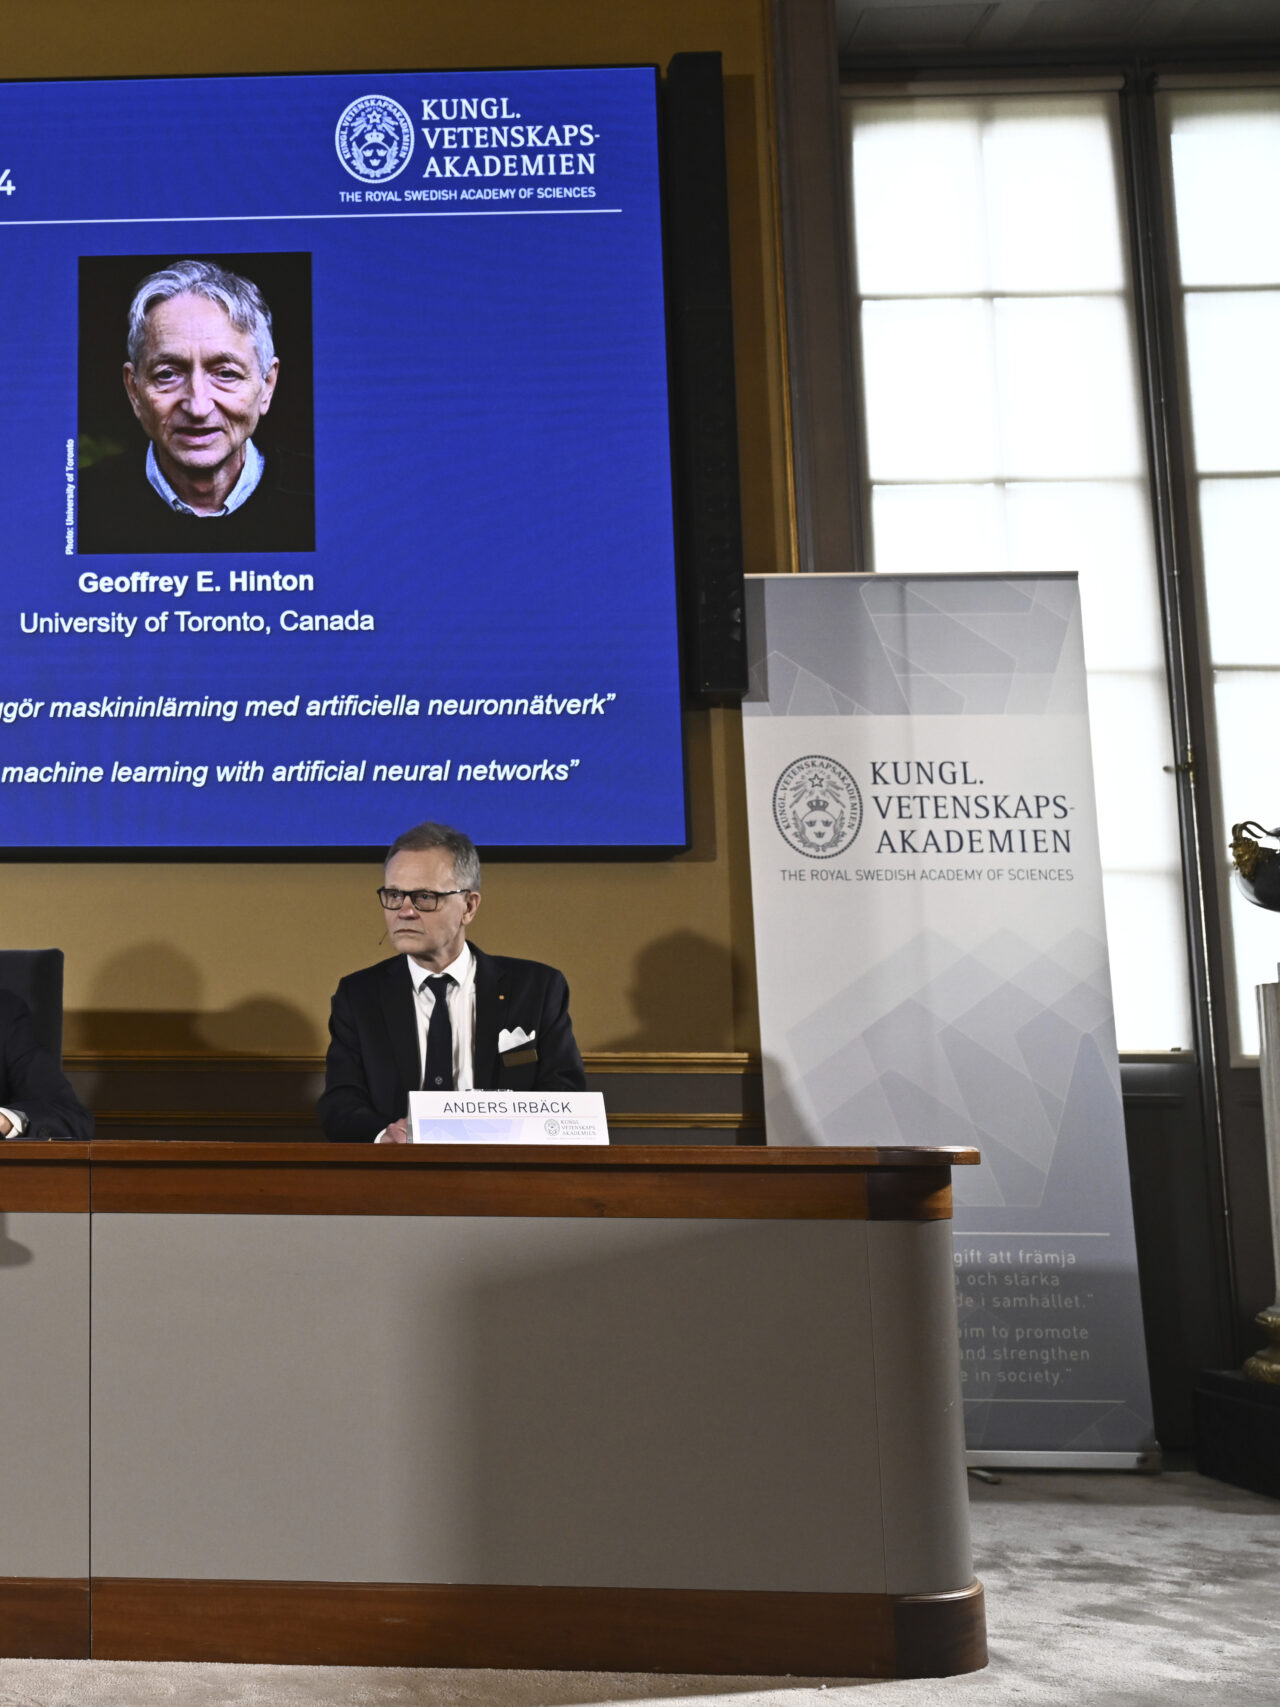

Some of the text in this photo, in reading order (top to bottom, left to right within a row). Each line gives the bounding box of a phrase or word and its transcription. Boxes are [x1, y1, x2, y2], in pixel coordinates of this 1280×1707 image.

[421, 97, 521, 121] KUNGL.
[421, 124, 601, 150] VETENSKAPS-
[422, 152, 596, 178] AKADEMIEN
[339, 186, 597, 202] THE ROYAL SWEDISH ACADEMY OF SCIENCES
[65, 438, 75, 555] Photo: University of Toronto
[78, 570, 314, 598] Geoffrey E. Hinton
[20, 609, 375, 638] University of Toronto, Canada
[49, 695, 239, 722] maskininlärning
[244, 694, 301, 717] med
[305, 694, 420, 717] artificiella
[0, 761, 104, 783] machine
[110, 760, 209, 788] learning
[216, 760, 265, 783] with
[271, 759, 367, 782] artificial
[372, 759, 451, 782] neural
[456, 758, 580, 781] networks”
[870, 761, 984, 786] KUNGL.
[871, 794, 1076, 820] VETENSKAPS-
[874, 829, 1071, 854] AKADEMIEN
[779, 868, 1074, 882] THE ROYAL SWEDISH ACADEMY OF SCIENCES
[443, 1099, 572, 1114] ANDERS IRBÄCK
[953, 1249, 1077, 1269] gift att främja
[966, 1272, 998, 1287] och
[1003, 1272, 1061, 1287] stärka
[991, 1325, 1009, 1339] to
[1015, 1326, 1090, 1342] promote
[959, 1346, 1091, 1365] nd strengthen
[975, 1368, 991, 1383] in
